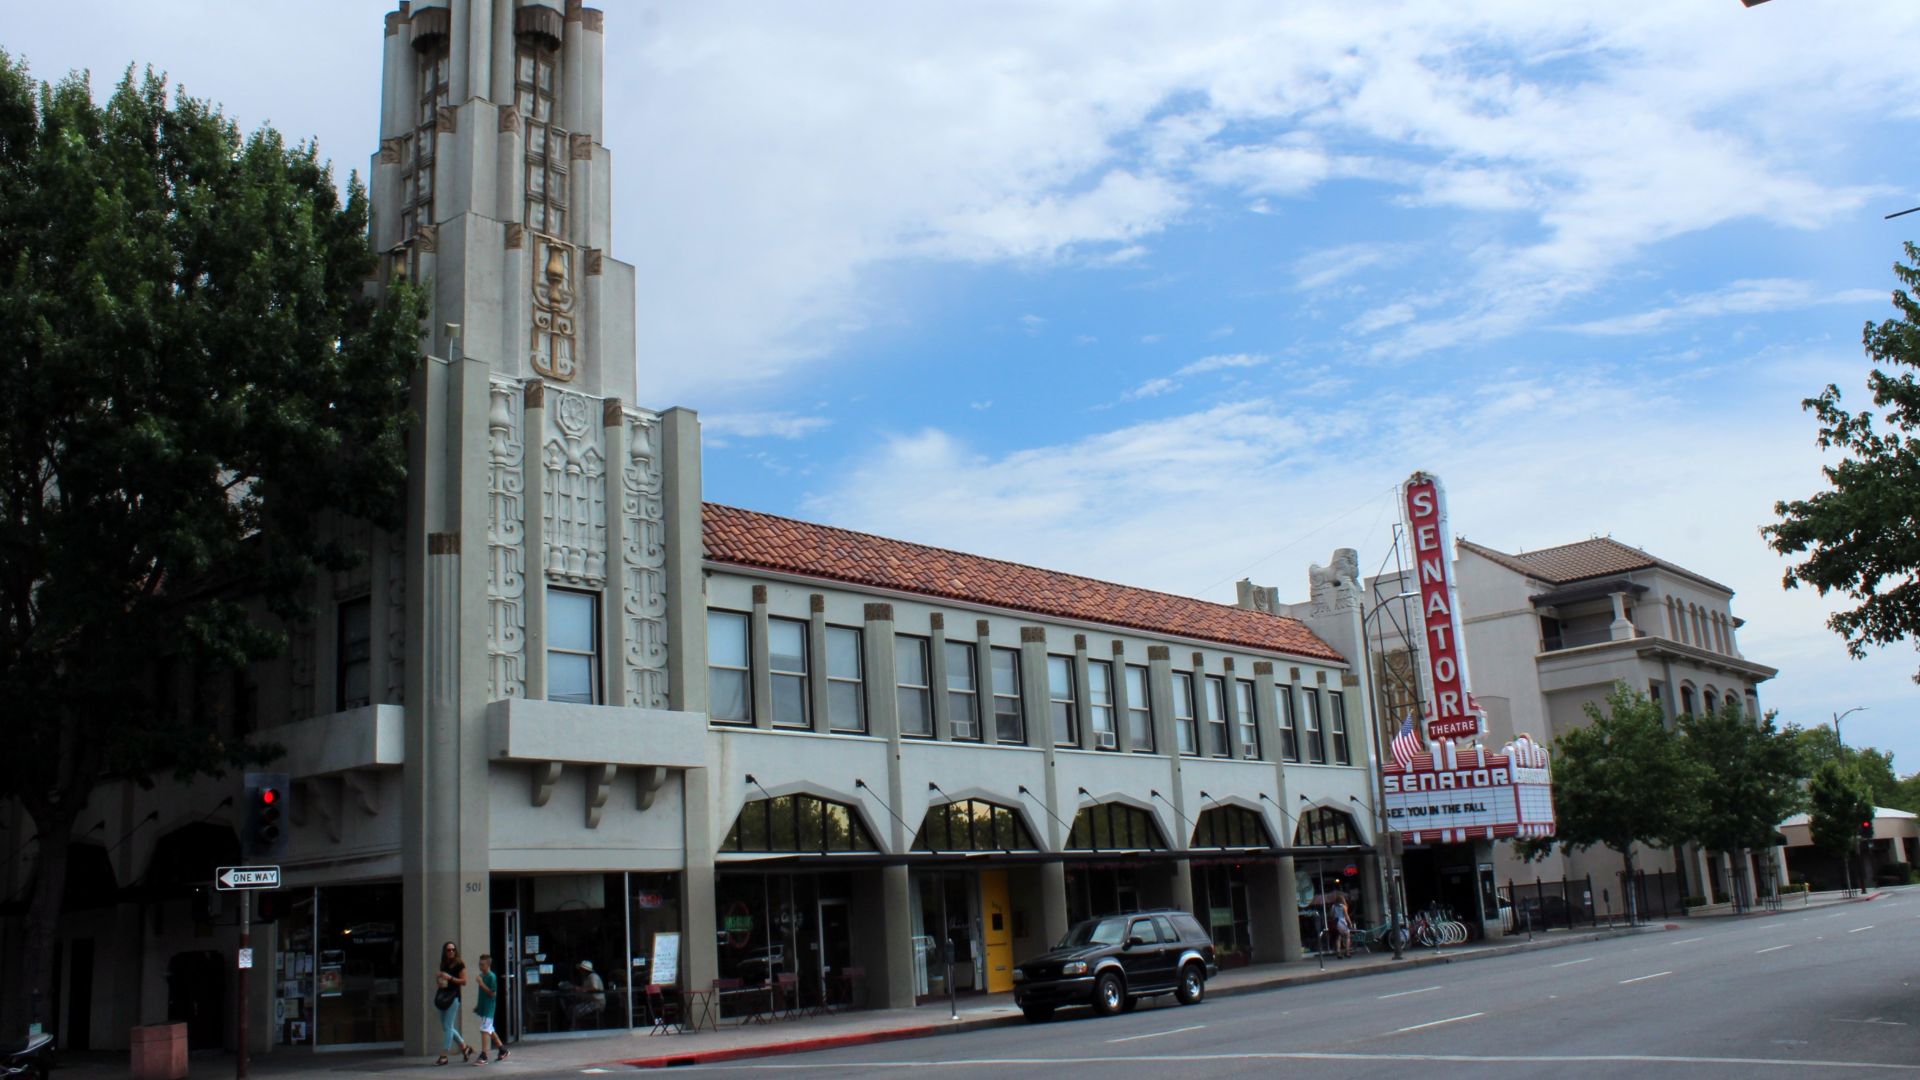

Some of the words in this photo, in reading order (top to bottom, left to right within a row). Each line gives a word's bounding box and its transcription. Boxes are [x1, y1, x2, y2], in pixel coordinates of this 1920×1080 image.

[1412, 490, 1459, 718] SENATOR
[1430, 720, 1475, 735] THEATRE
[1383, 767, 1509, 793] SENATOR
[1407, 806, 1427, 817] YOU
[1429, 805, 1439, 815] IN
[1441, 803, 1461, 814] THE
[1464, 802, 1487, 813] FALL
[233, 873, 252, 882] ONE
[255, 872, 276, 881] WAY
[465, 881, 481, 893] 501
